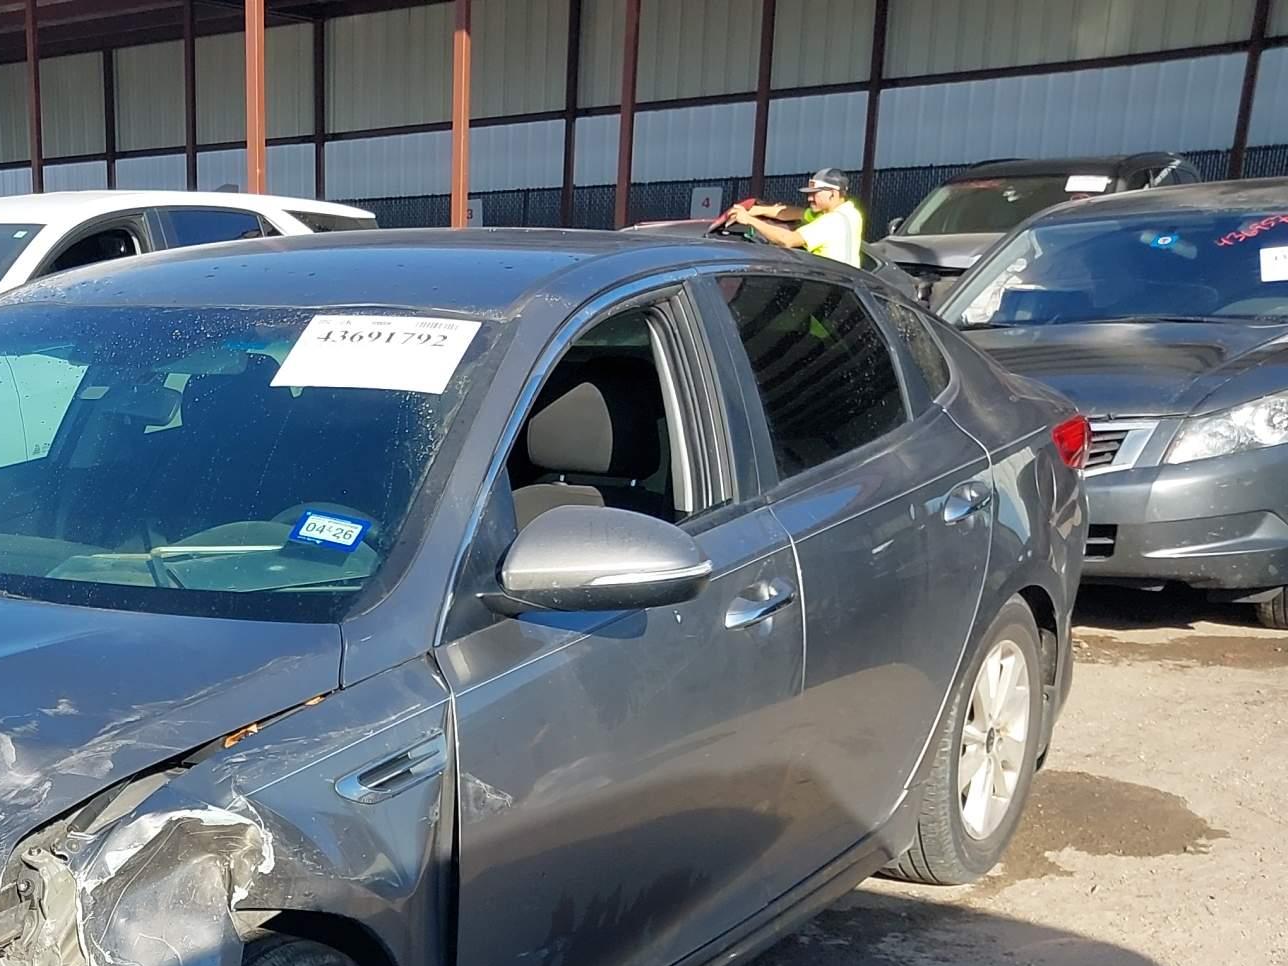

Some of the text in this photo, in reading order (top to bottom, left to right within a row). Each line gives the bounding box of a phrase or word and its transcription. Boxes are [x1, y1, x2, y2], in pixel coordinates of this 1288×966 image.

[702, 197, 711, 208] 4
[316, 330, 448, 347] 43691792
[332, 527, 354, 540] 26
